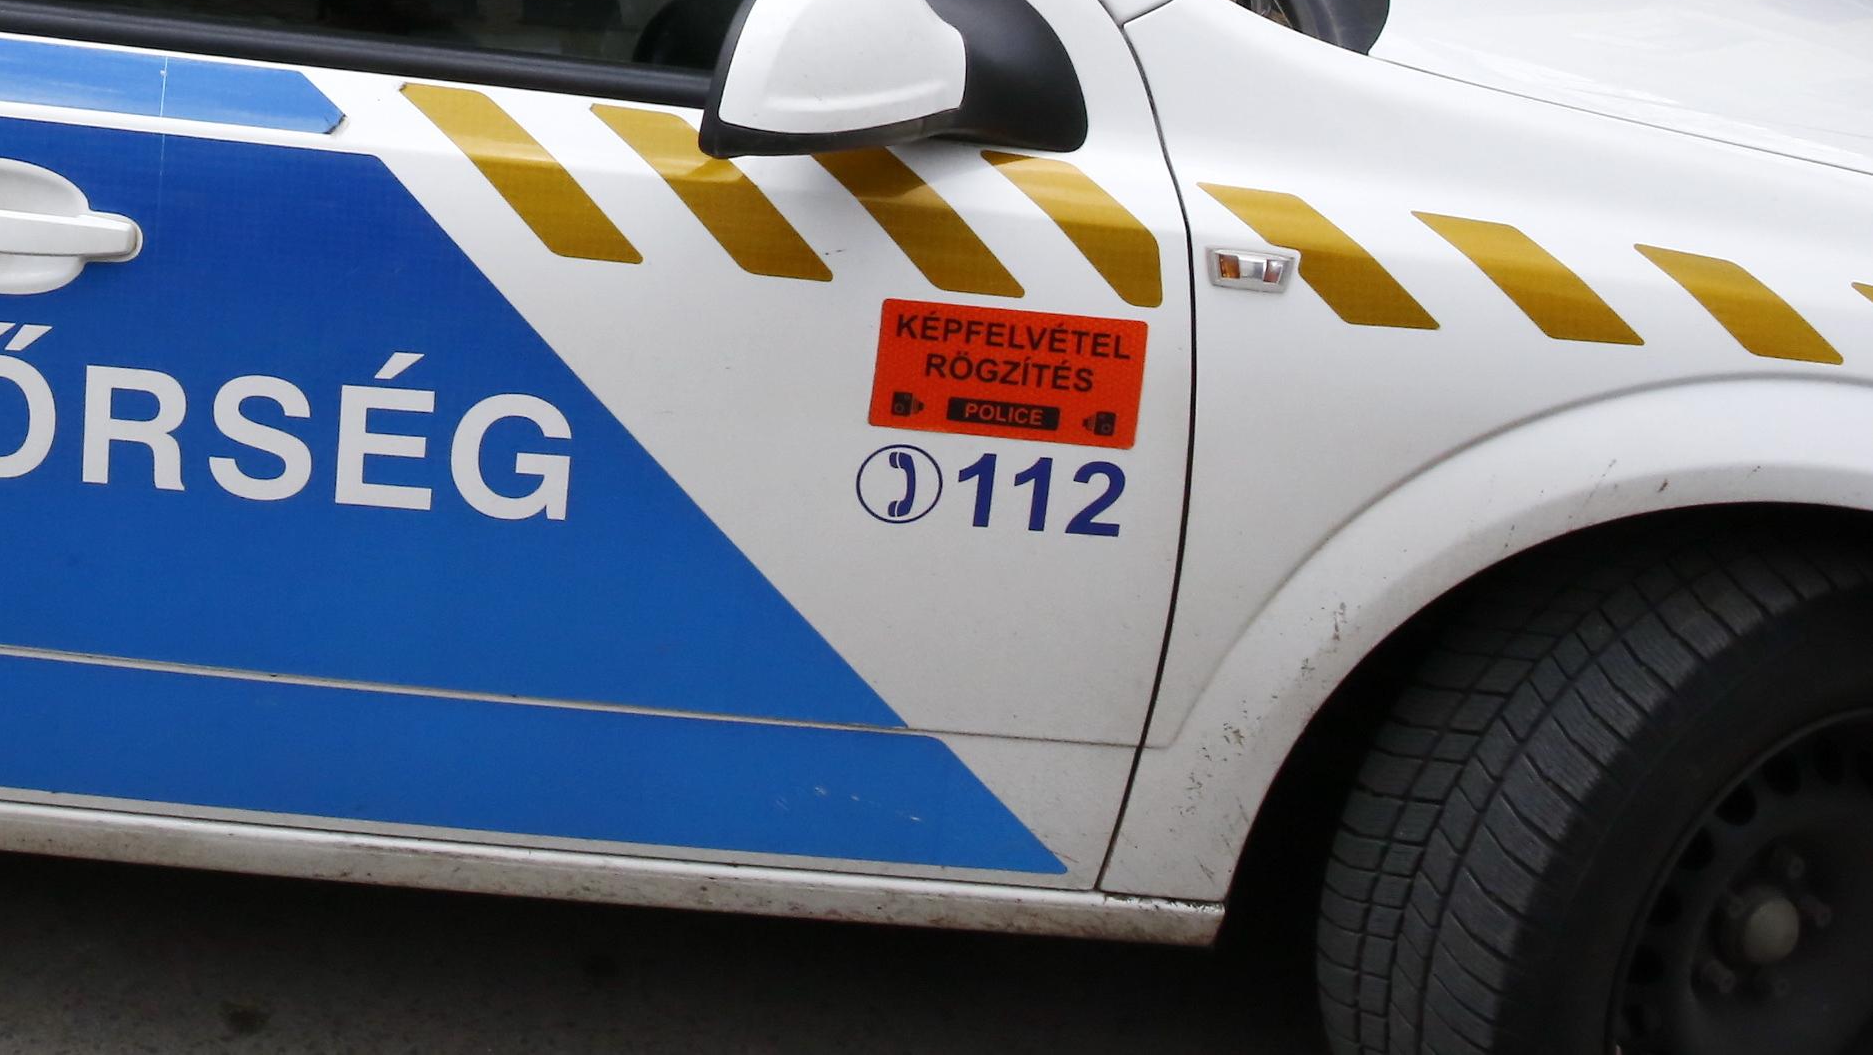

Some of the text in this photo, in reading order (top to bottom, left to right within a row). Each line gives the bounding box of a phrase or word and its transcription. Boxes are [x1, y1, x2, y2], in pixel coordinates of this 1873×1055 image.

[895, 313, 1131, 361] KÉPFELVÉTEL
[924, 352, 1095, 392] RÖGZÍTÉS
[963, 402, 1044, 427] POLICE
[957, 452, 1127, 537] 112
